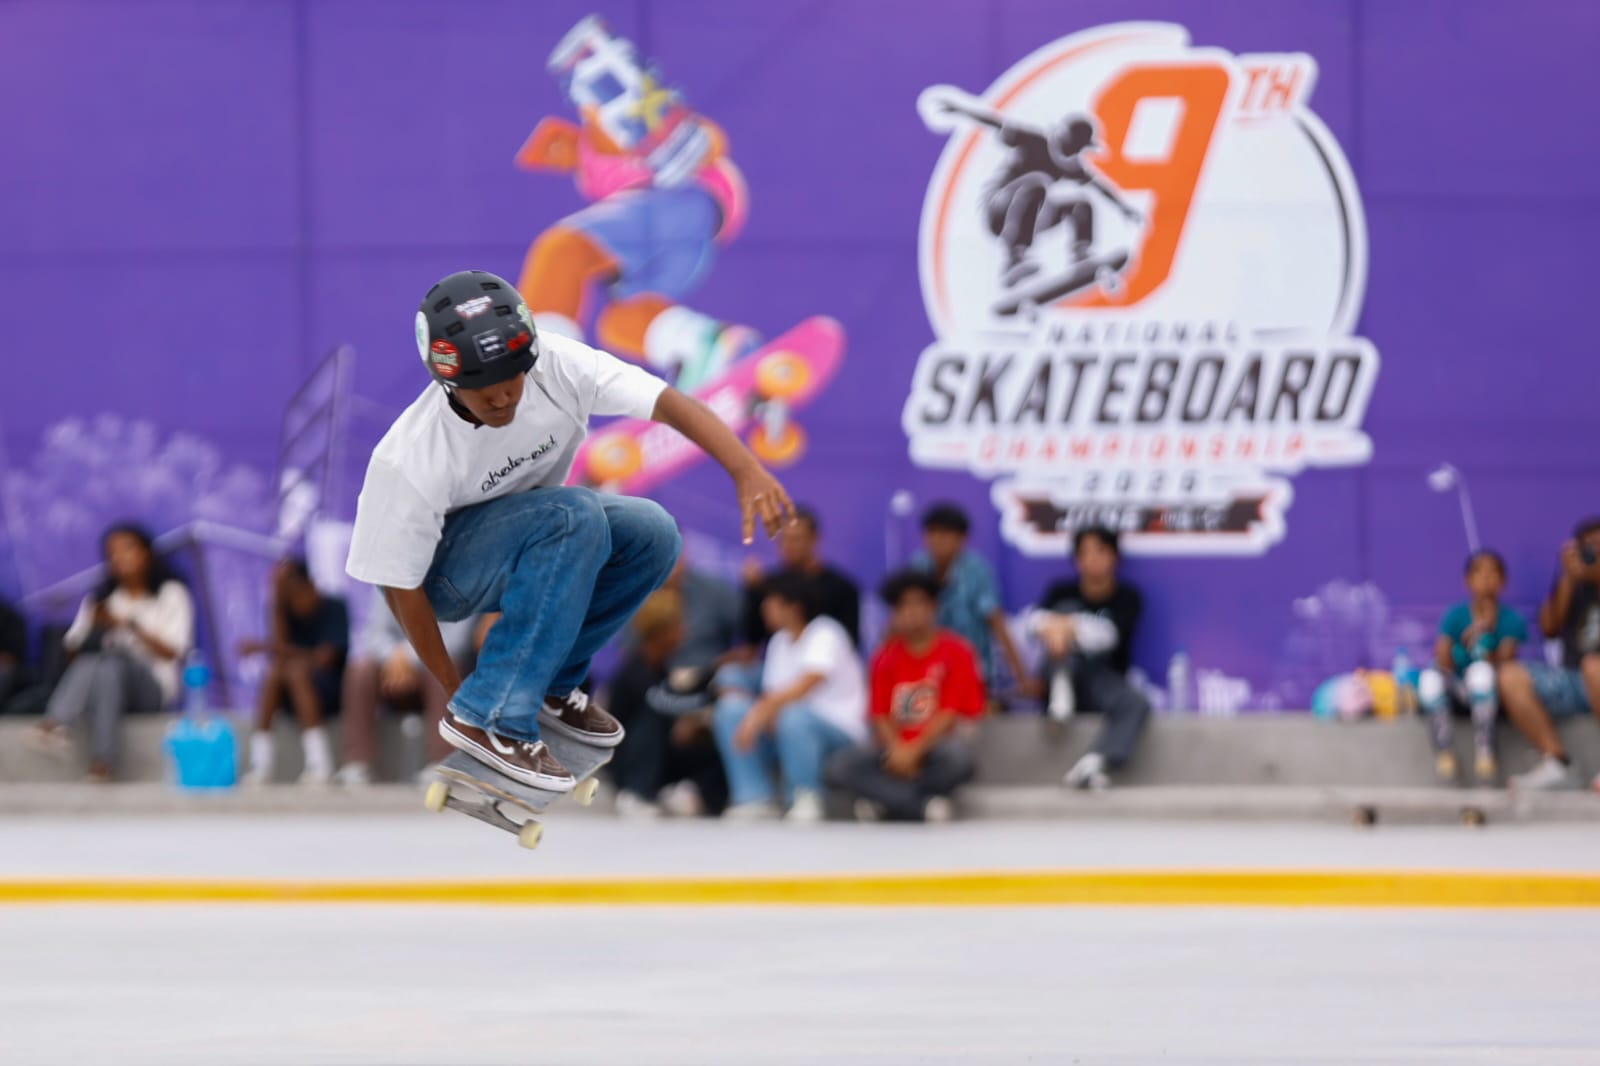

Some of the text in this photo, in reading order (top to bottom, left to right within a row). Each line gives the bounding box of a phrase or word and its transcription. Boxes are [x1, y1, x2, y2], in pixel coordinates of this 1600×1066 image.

[1045, 323, 1241, 344] NATIONAL
[921, 353, 1363, 425] SKATEBOARD
[979, 432, 1305, 459] CHAMPIONSHIP
